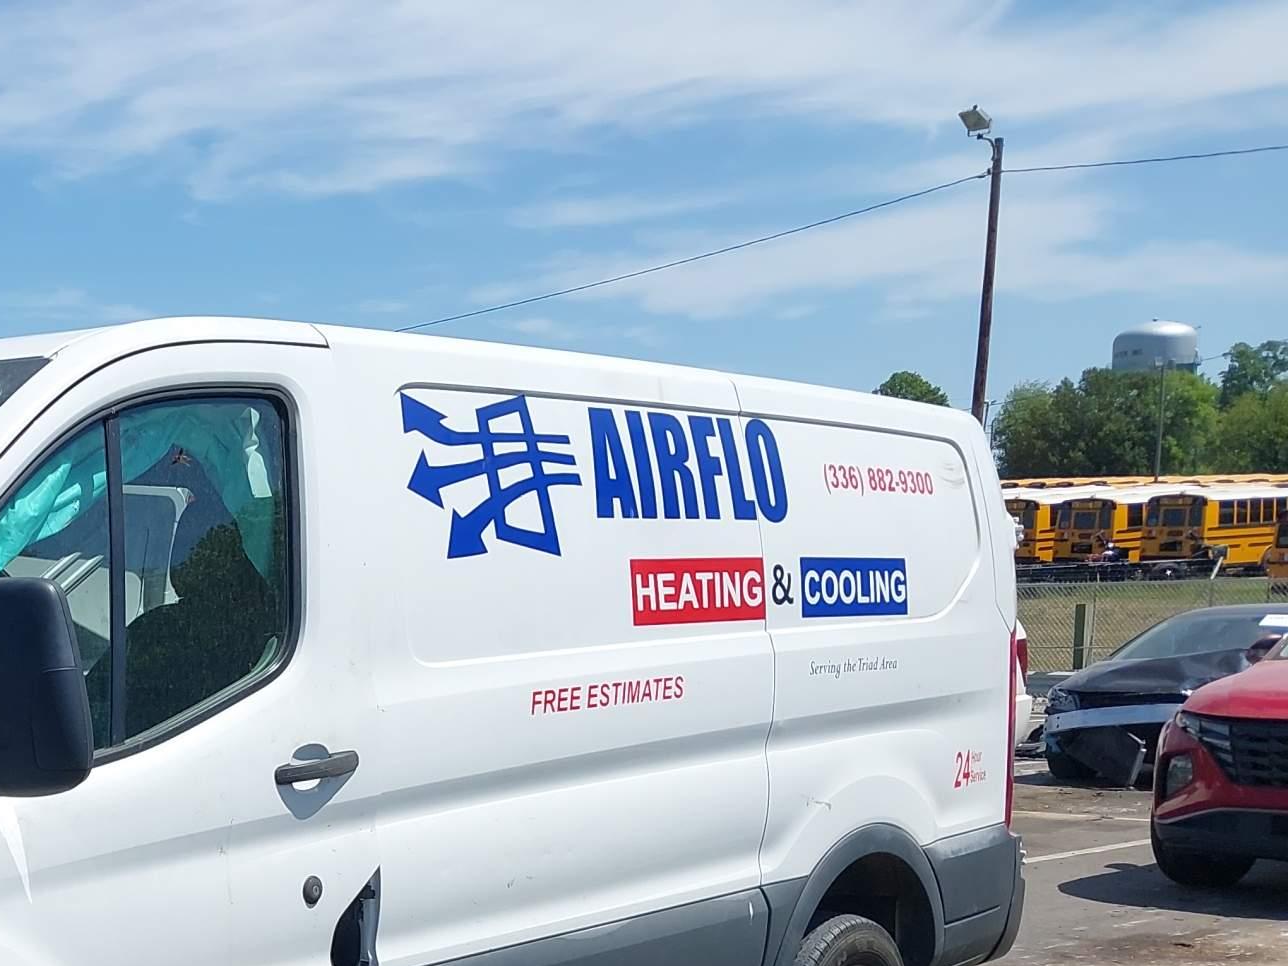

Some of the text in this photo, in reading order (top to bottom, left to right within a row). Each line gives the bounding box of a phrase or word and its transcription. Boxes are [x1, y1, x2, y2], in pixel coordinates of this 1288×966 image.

[588, 407, 788, 523] AIRFLO
[823, 463, 933, 496] (336) 882-9300
[635, 564, 907, 612] HEATING & COOLING
[809, 656, 898, 679] Serving the Triad Area
[531, 675, 684, 715] FREE ESTIMATES
[954, 749, 970, 788] 24
